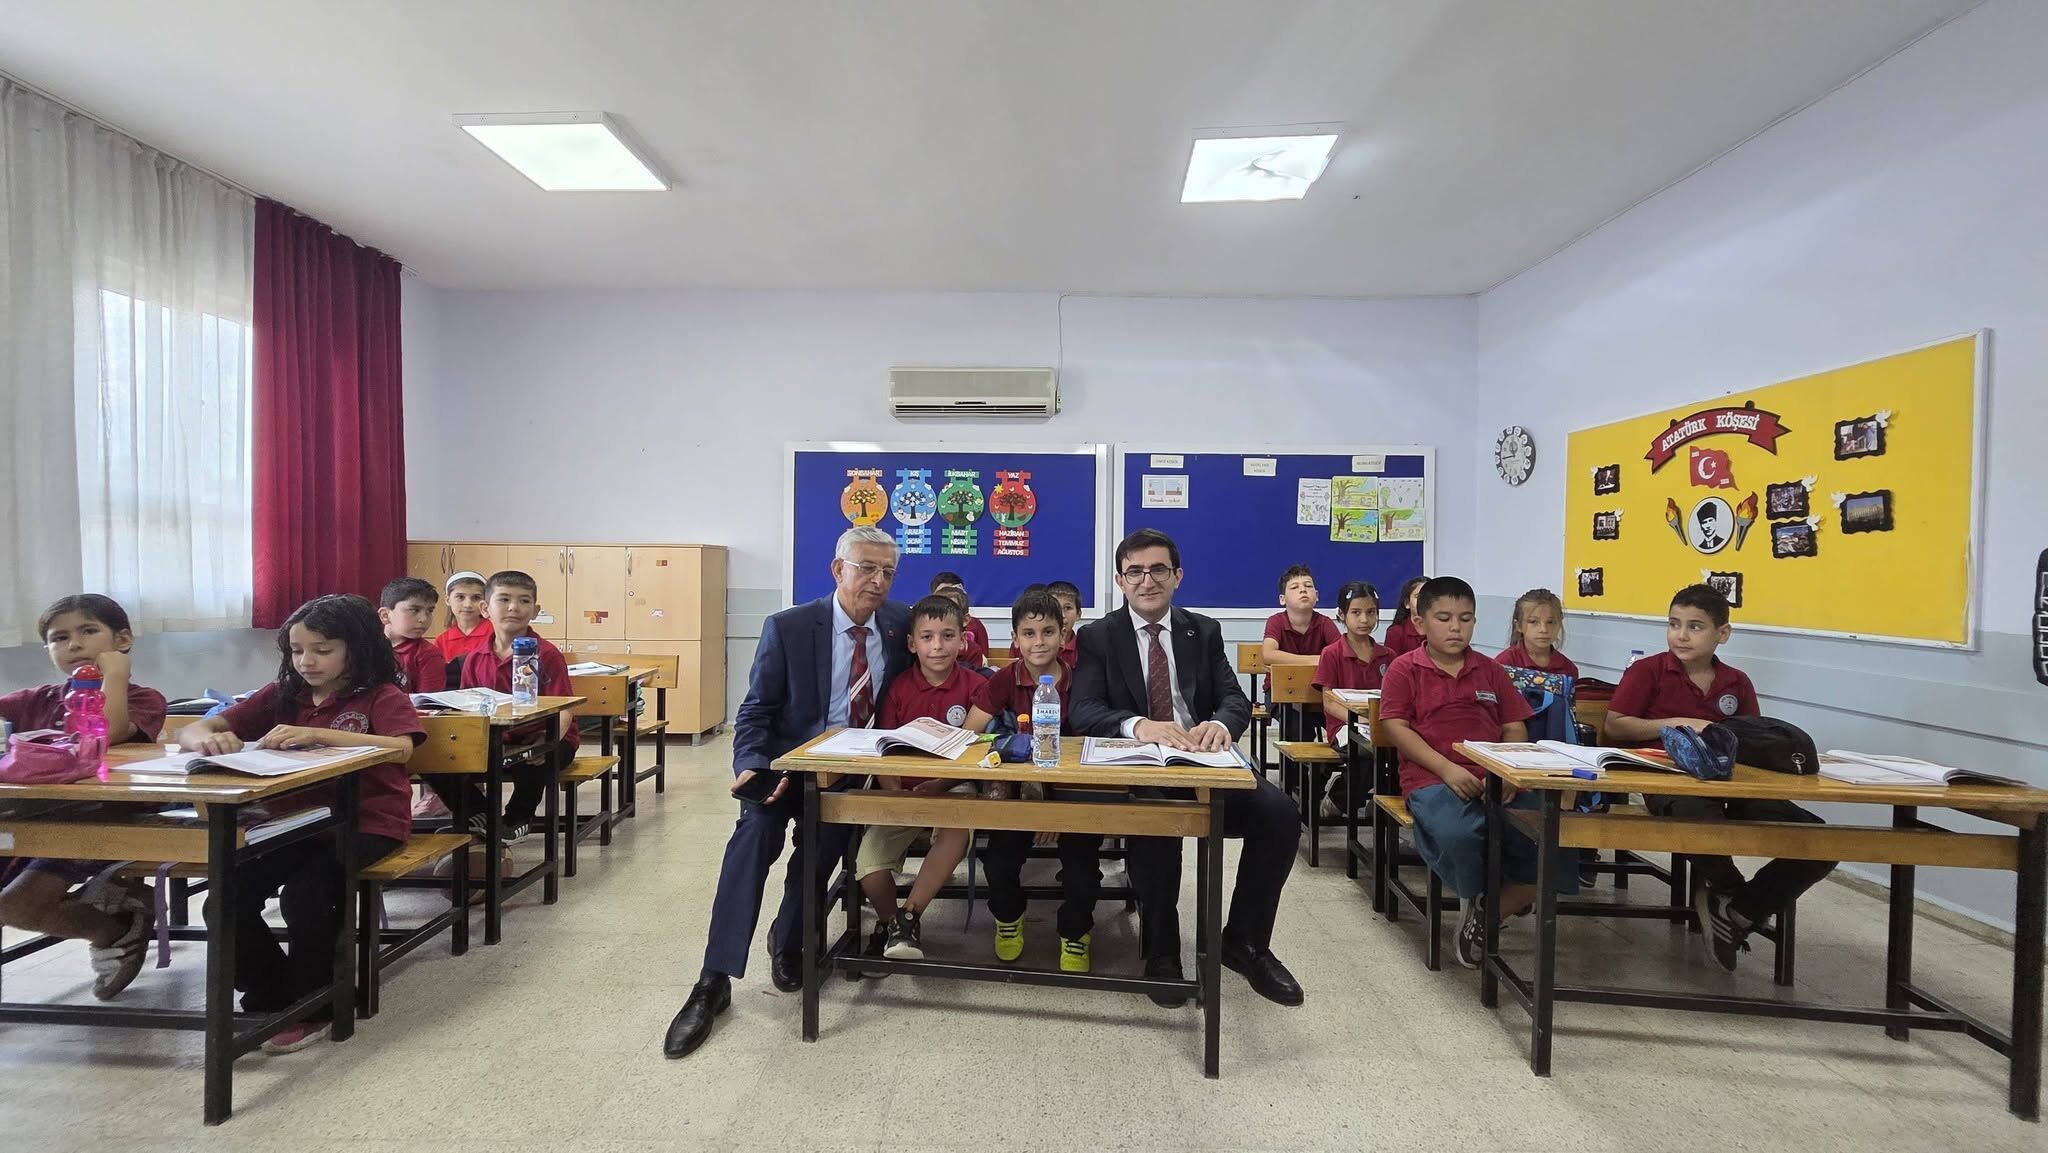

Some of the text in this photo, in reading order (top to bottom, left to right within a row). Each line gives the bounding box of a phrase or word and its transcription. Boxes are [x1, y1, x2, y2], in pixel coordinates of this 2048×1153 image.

[1661, 412, 1760, 452] ATATÜRK KÖŞESİ
[996, 547, 1024, 555] AĞUSTOS
